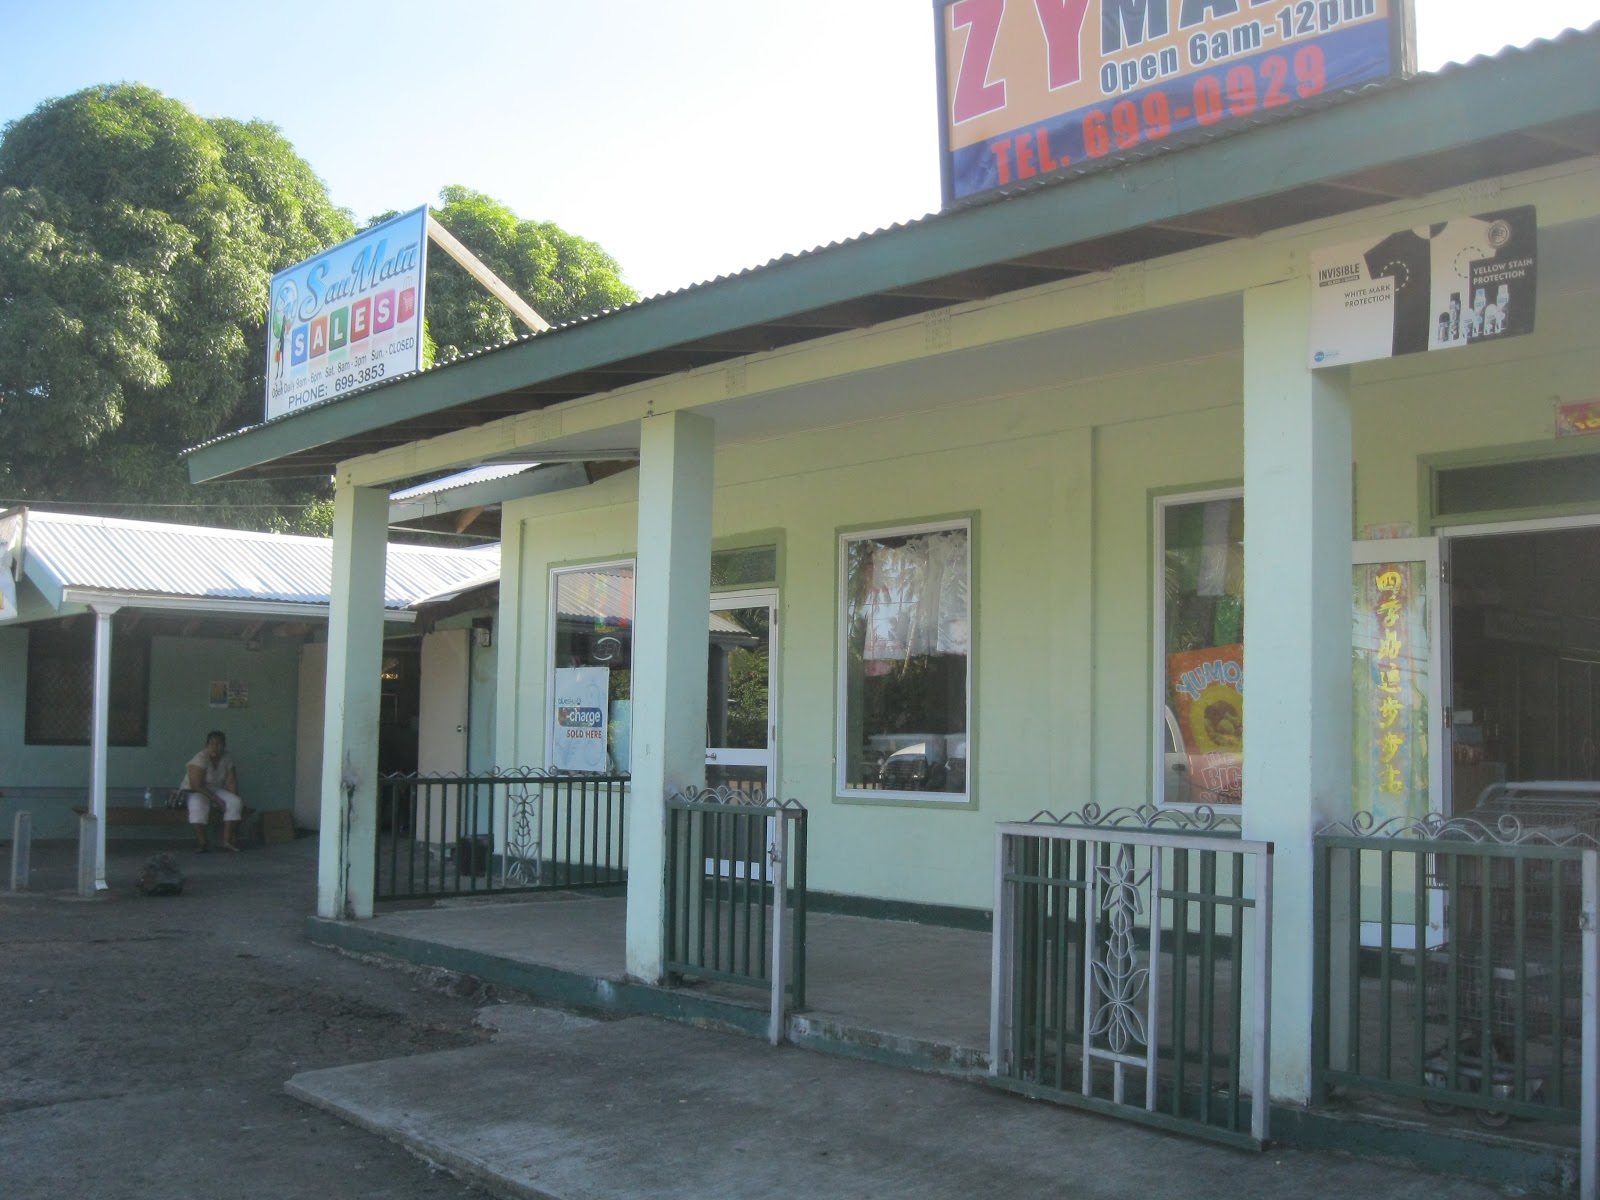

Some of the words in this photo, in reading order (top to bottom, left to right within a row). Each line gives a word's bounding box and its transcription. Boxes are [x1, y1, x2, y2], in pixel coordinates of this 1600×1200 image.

[1100, 45, 1179, 94] Open
[1188, 0, 1376, 67] 6am-12pm
[991, 128, 1070, 186] TEL.
[1082, 44, 1327, 157] 699-0929
[1318, 263, 1360, 281] INVISIBLE
[1473, 262, 1507, 275] YELLOW
[1508, 257, 1534, 270] STAIN
[1473, 269, 1526, 285] PROTECTION
[1344, 288, 1367, 298] WHITE
[1369, 284, 1391, 295] MARK
[1344, 293, 1391, 308] PROTECTION
[293, 296, 392, 359] SALES
[311, 370, 323, 384] 6pm
[325, 365, 335, 378] Sat.
[338, 361, 351, 373] 8am
[354, 355, 367, 368] 3pm
[371, 349, 384, 361] Sun.
[389, 336, 415, 356] CLOSED
[288, 383, 328, 409] PHONE:
[335, 362, 385, 392] 699-3853
[566, 729, 584, 739] SOLD
[586, 729, 602, 739] HERE
[1200, 765, 1243, 792] BIG
